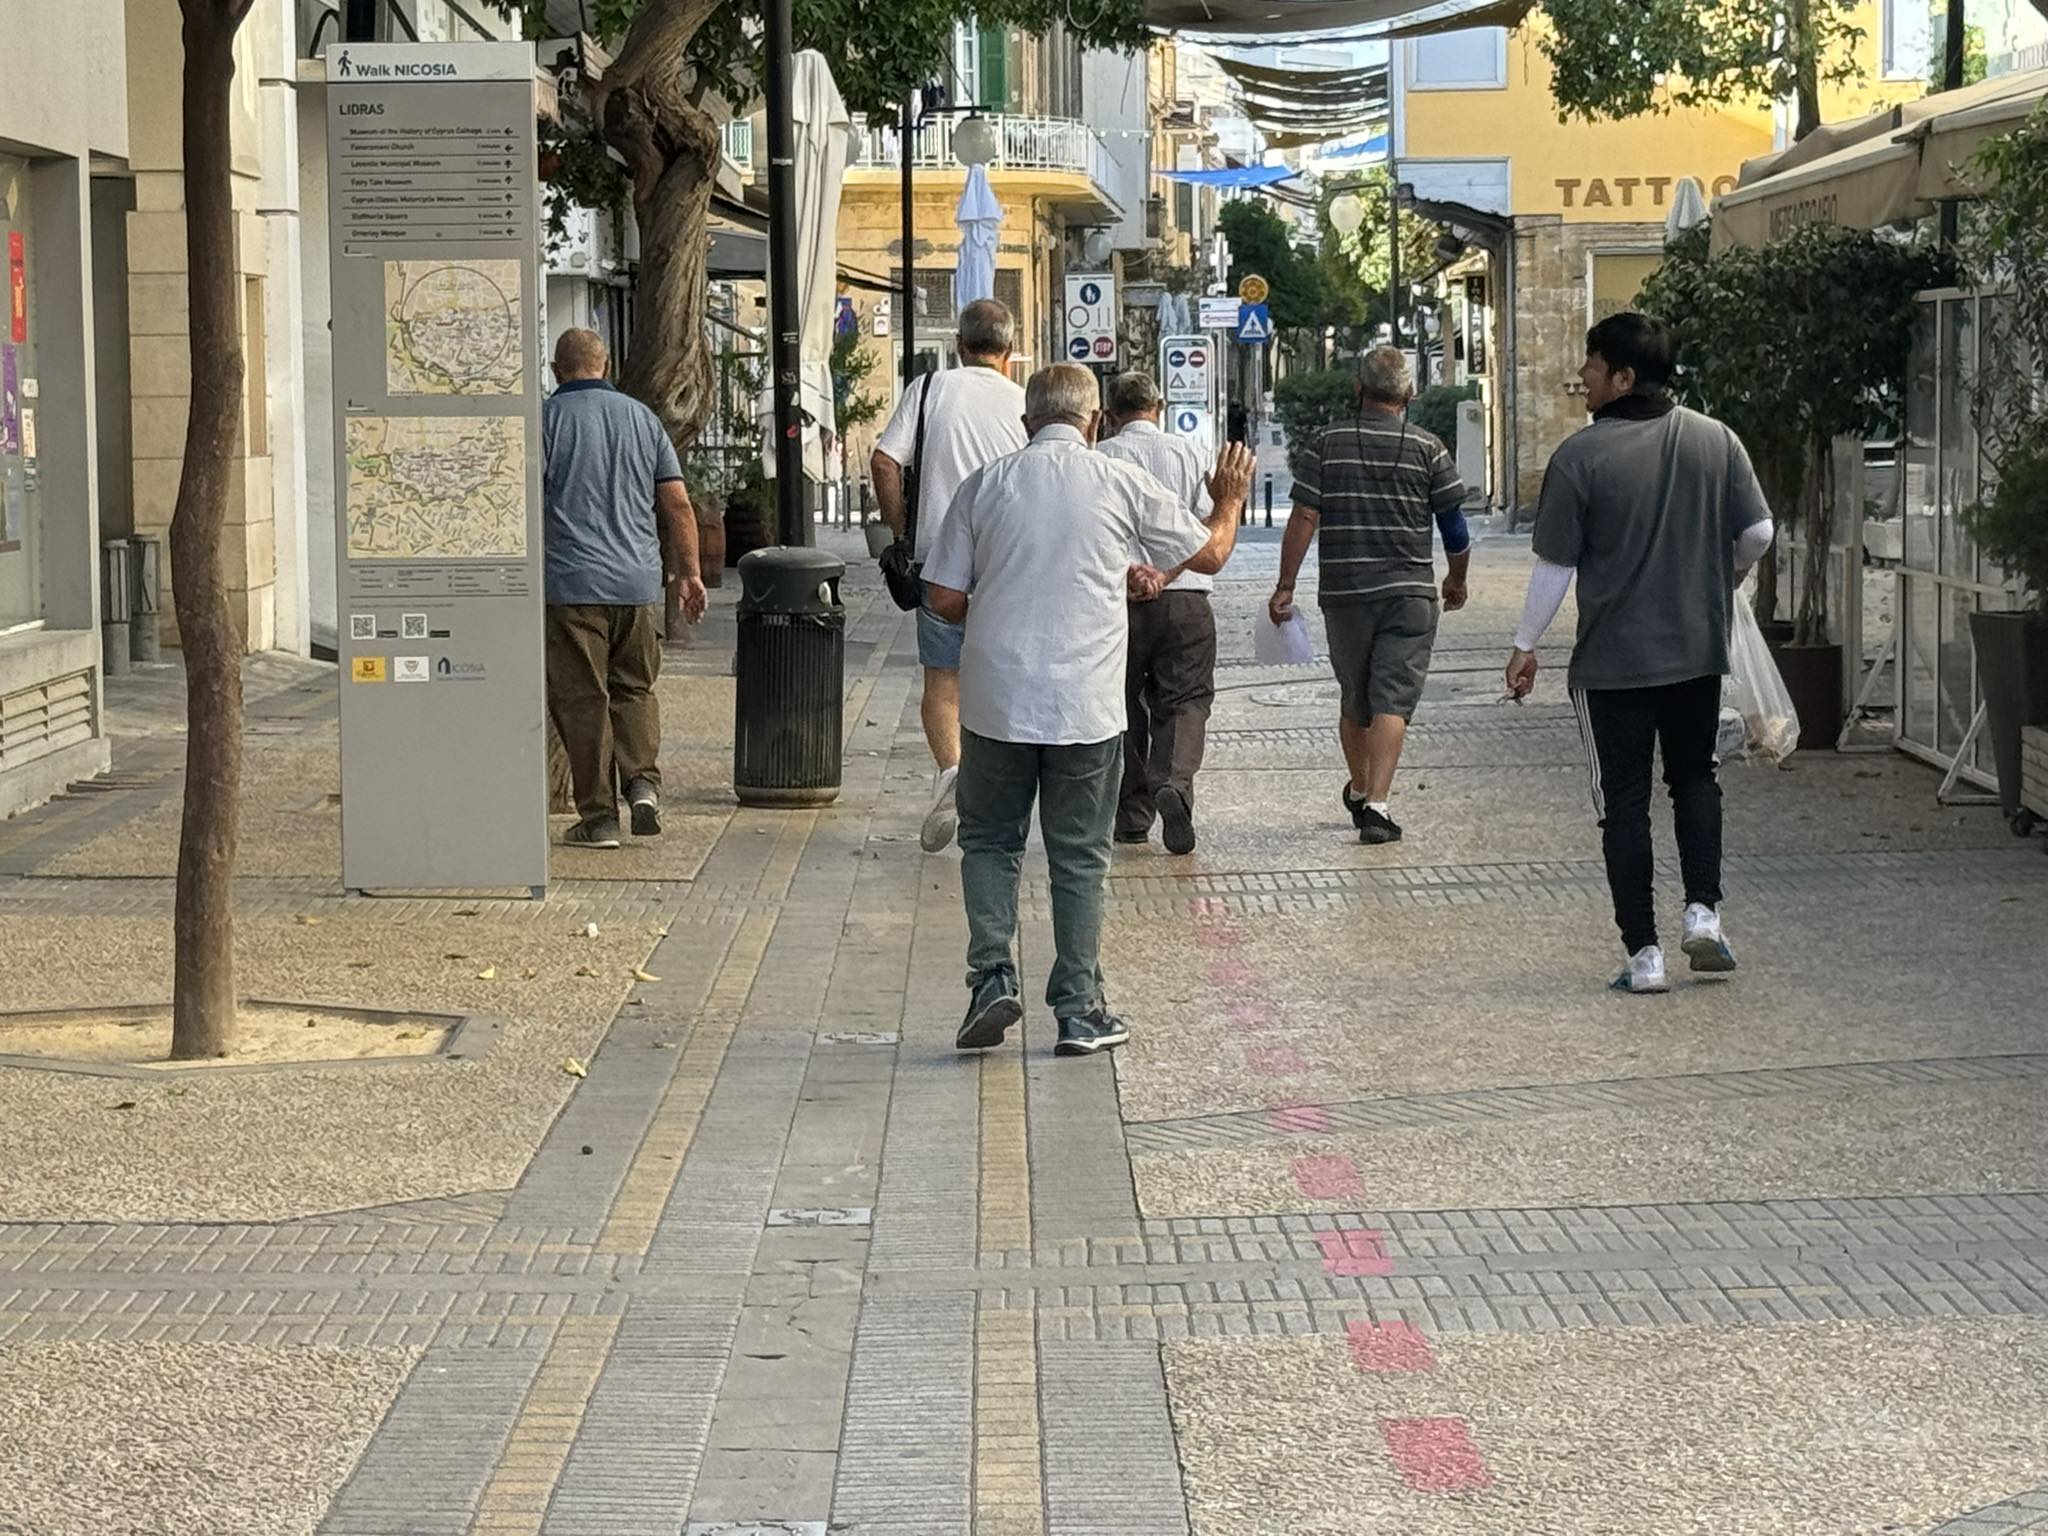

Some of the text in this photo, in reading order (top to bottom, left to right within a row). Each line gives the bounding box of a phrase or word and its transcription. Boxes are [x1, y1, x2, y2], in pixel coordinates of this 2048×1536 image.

[355, 63, 458, 77] Walk NICOSIA
[338, 103, 385, 116] LIDRAS
[1554, 175, 1738, 207] TATTO
[1095, 341, 1112, 353] STOP
